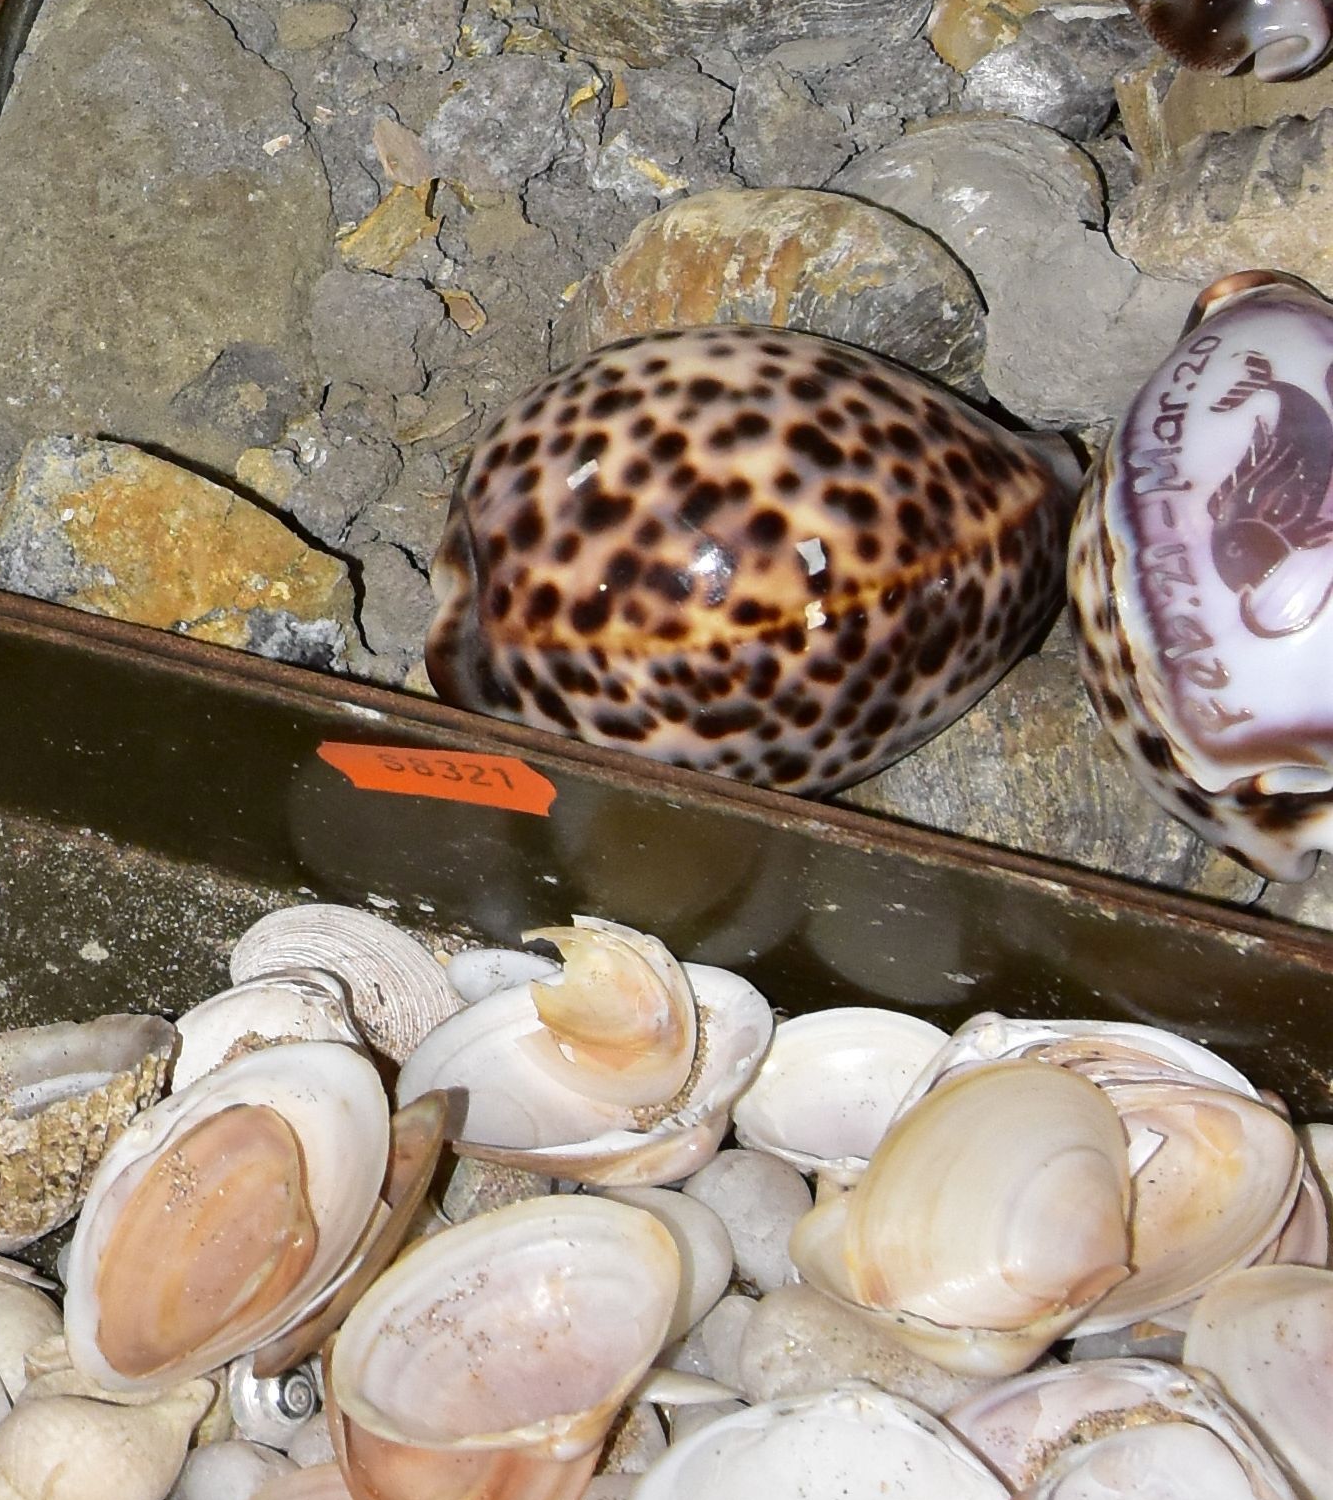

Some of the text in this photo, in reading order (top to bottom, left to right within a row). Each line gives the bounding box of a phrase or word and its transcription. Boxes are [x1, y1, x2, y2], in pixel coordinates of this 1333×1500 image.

[1131, 334, 1223, 496] Mar.20
[1141, 542, 1254, 733] Feb.21
[378, 752, 515, 790] S8321
